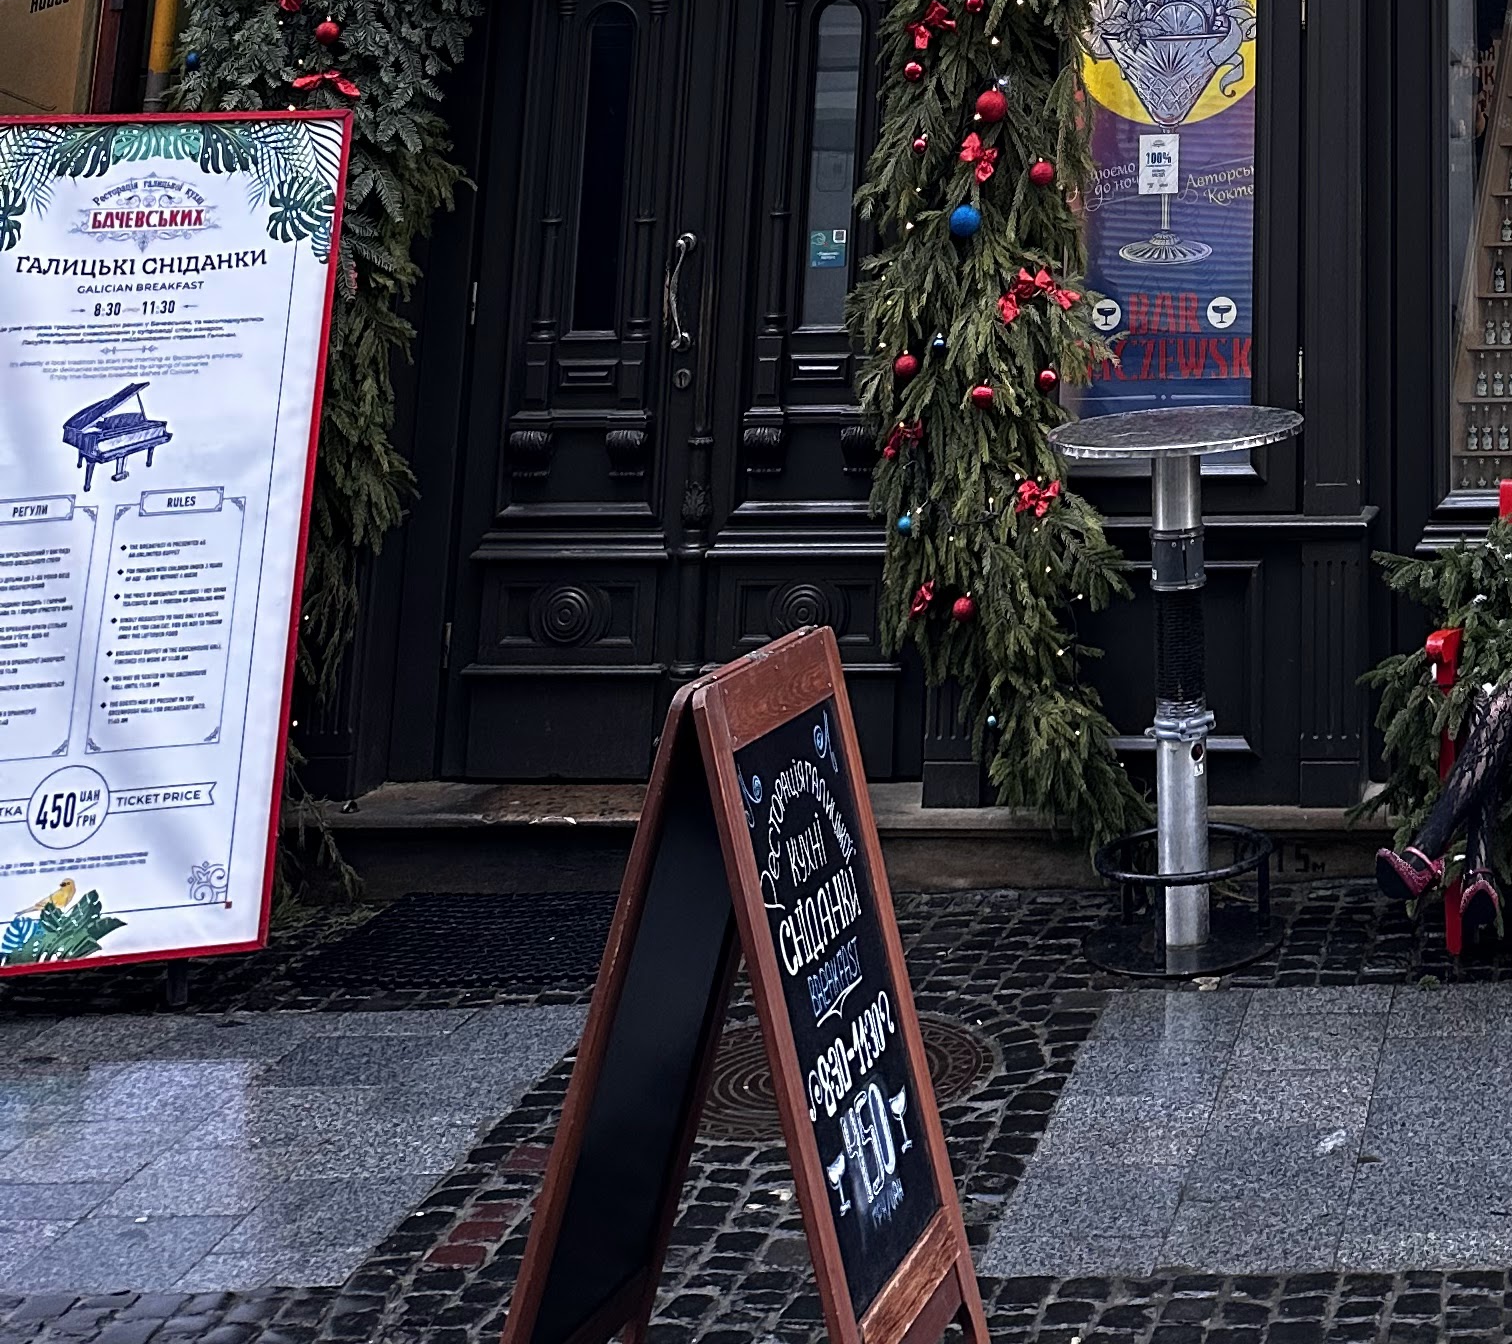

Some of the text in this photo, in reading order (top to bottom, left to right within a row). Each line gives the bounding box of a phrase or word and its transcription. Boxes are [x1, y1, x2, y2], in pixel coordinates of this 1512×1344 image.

[1145, 151, 1172, 165] 100%
[92, 208, 205, 230] БАЧЕВСЬКИХ
[16, 248, 267, 279] ГАЛИЦЬКІ СНІДАНКИ
[77, 280, 205, 294] GALICIAN BREAKFAST
[93, 299, 176, 317] 8:30 11:30
[1128, 292, 1202, 335] BAR
[12, 504, 49, 518] РЕГУЛИ
[166, 495, 197, 508] RULES
[79, 789, 101, 803] UAH
[116, 789, 202, 807] TICKET PRICE
[35, 791, 77, 830] 450
[779, 865, 862, 977] СНІДАНКИ
[806, 935, 863, 1018] BREAKFAST
[839, 1082, 896, 1204] 450
